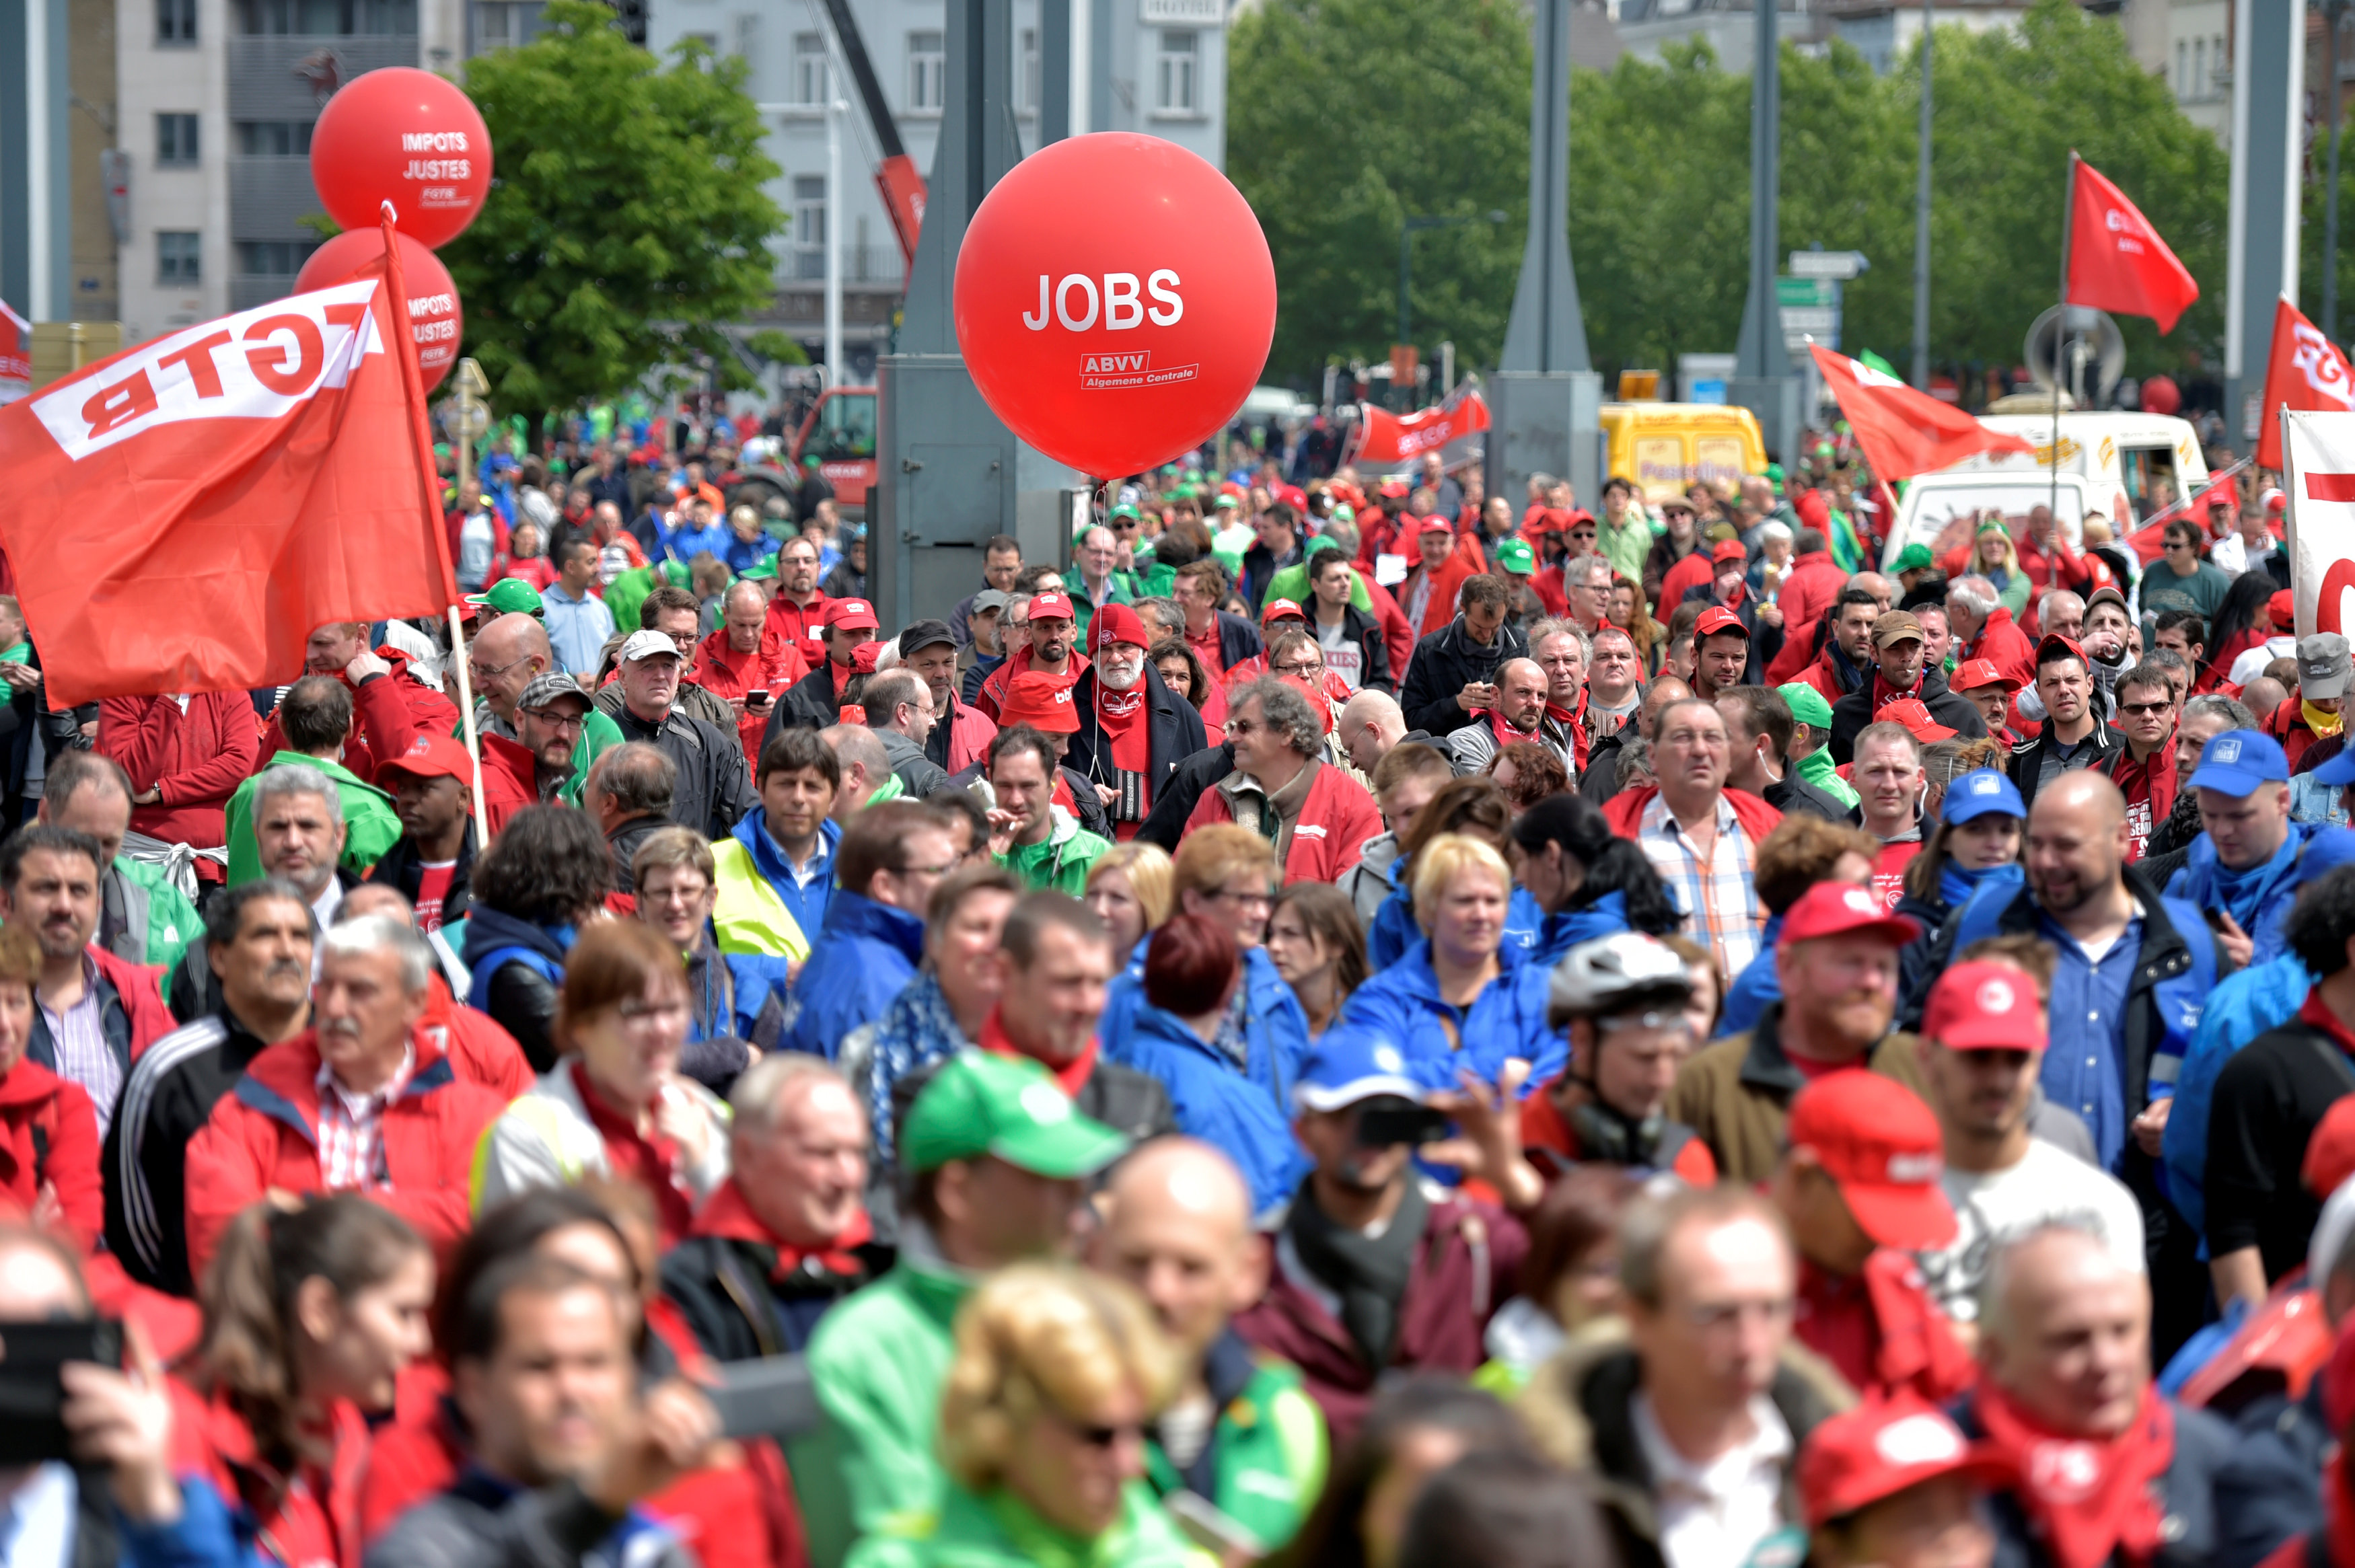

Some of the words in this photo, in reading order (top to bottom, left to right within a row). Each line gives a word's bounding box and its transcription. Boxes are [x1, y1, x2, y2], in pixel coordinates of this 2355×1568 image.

[402, 132, 469, 152] IMPOTS
[402, 159, 471, 180] JUSTES
[407, 293, 455, 318] MPOTS
[1022, 268, 1184, 332] JOBS
[412, 318, 457, 344] USTES
[1085, 354, 1144, 373] ABVV
[1086, 377, 1144, 388] Algemene
[1147, 369, 1194, 383] Centrale
